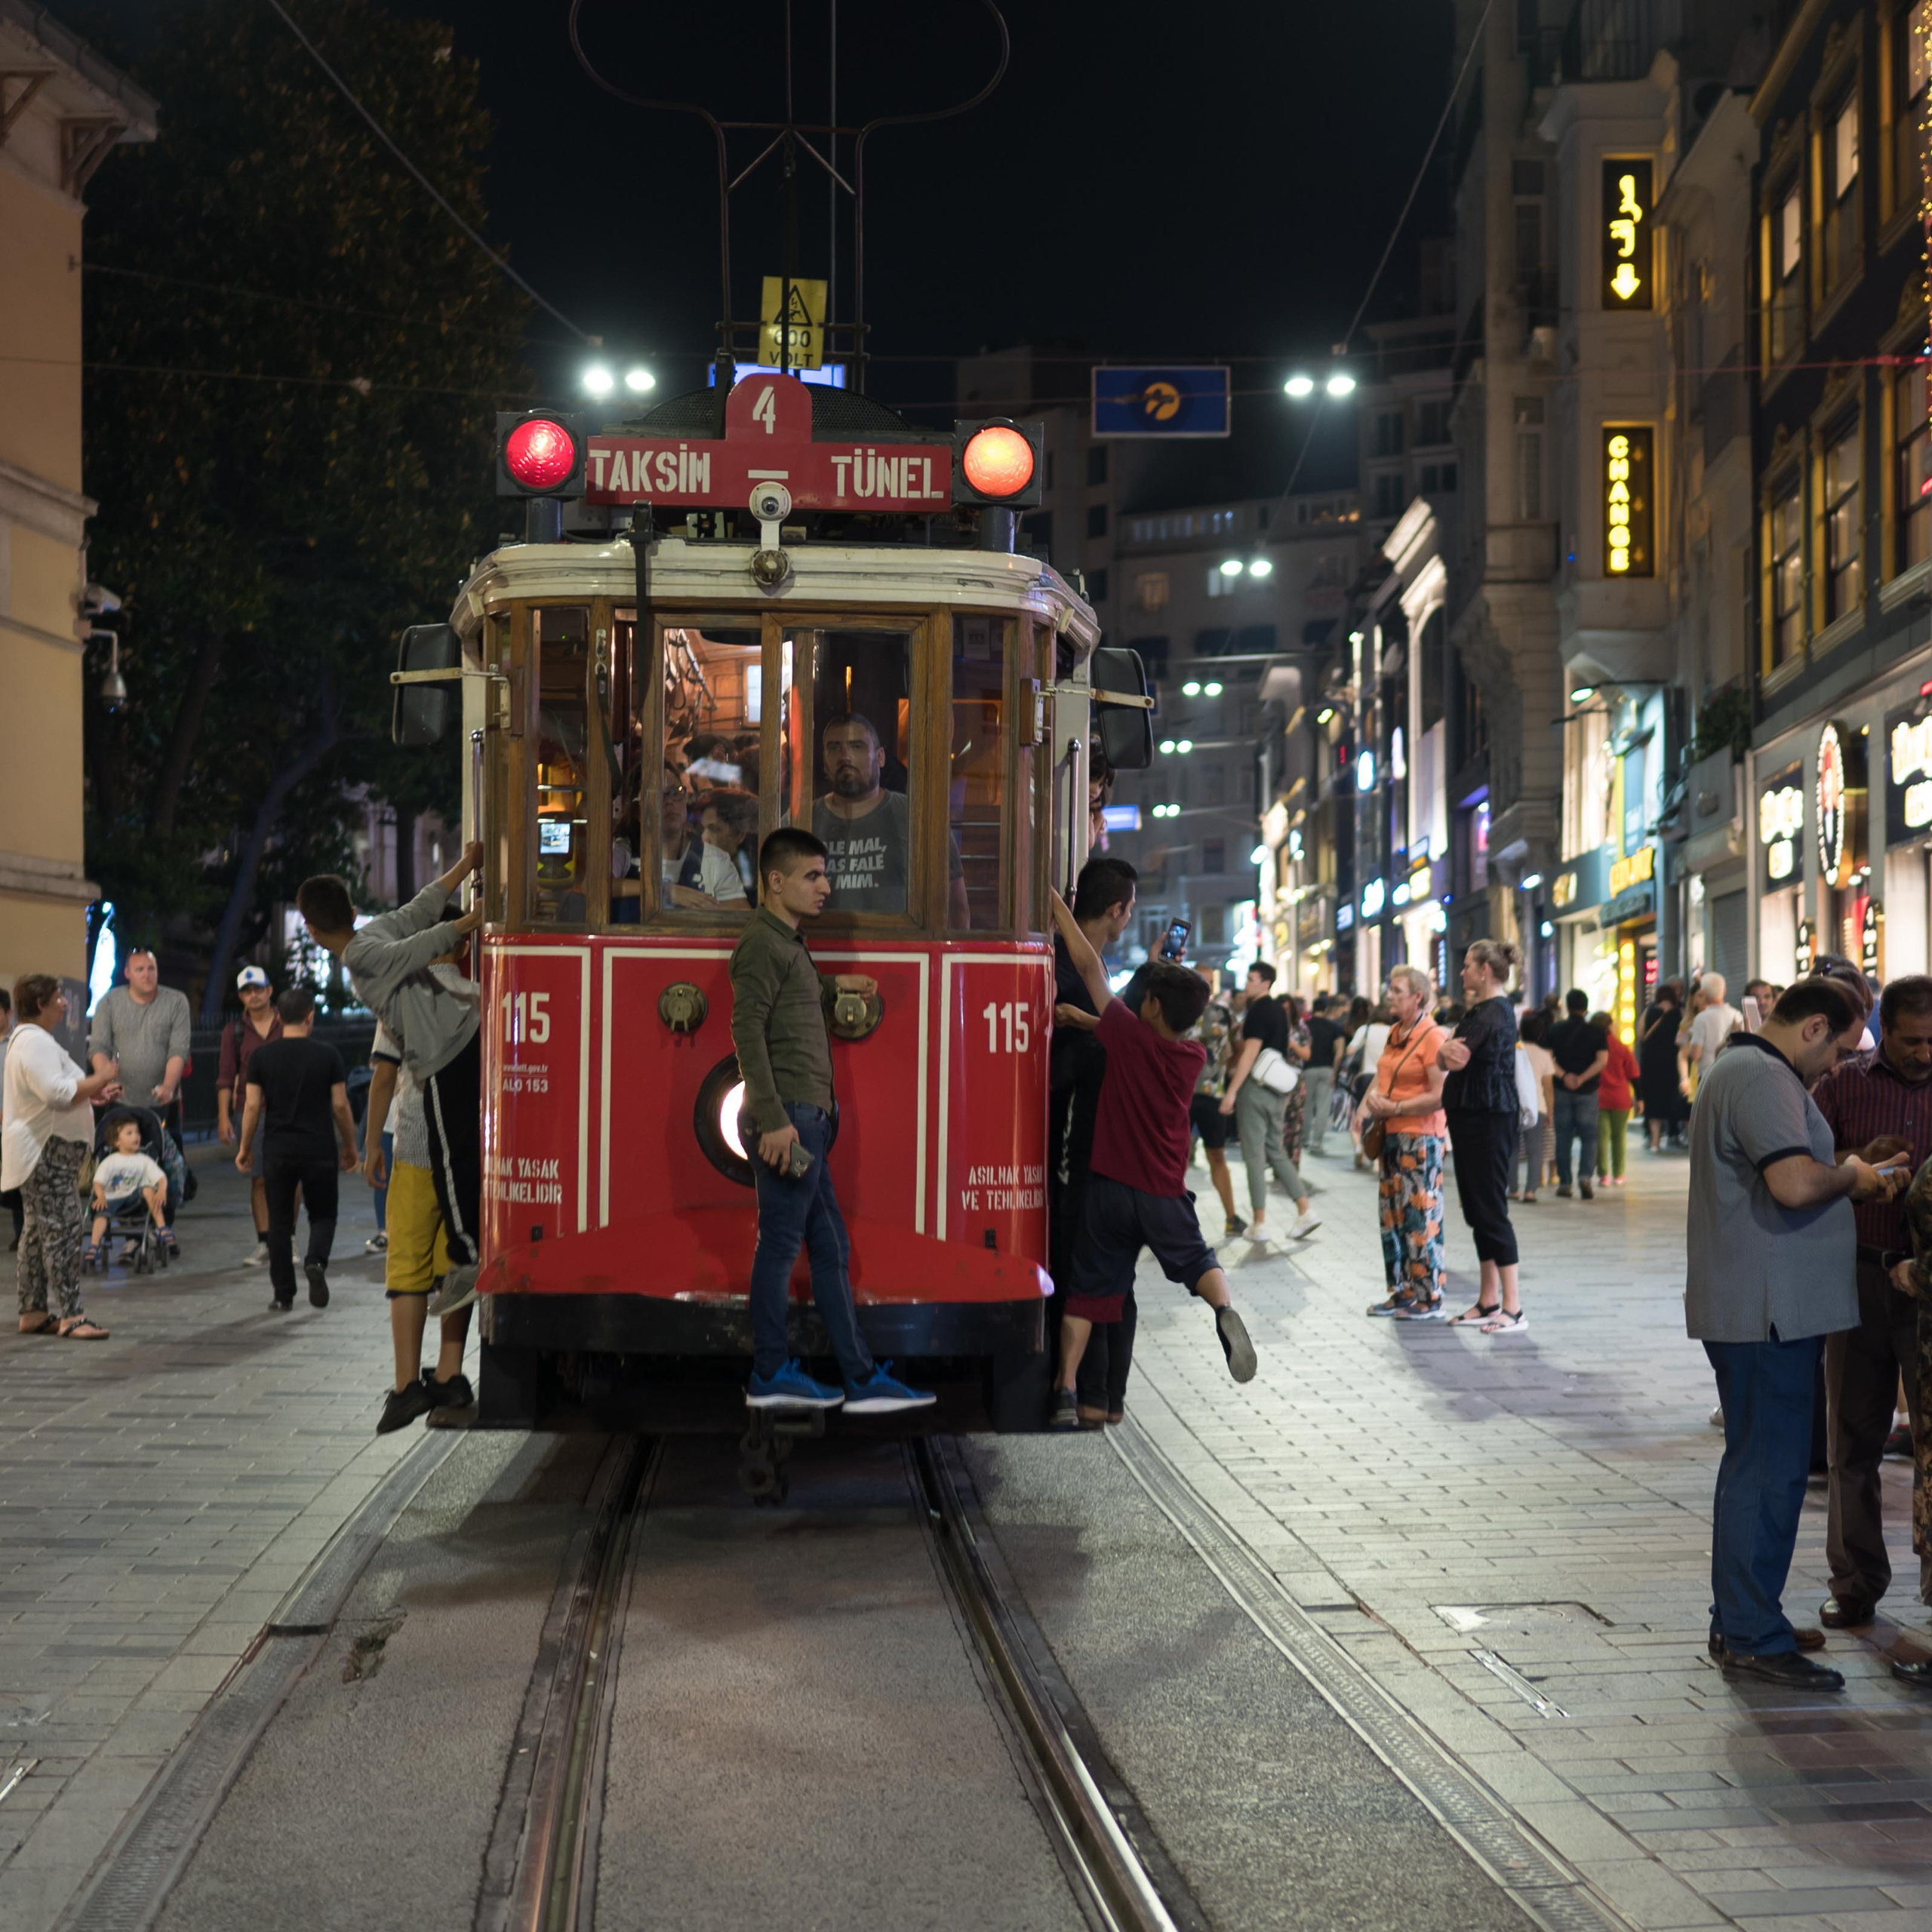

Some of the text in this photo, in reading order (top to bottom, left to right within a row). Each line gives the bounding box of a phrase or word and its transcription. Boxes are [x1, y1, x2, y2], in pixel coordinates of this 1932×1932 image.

[774, 330, 811, 347] 600
[770, 351, 814, 368] VOLT
[752, 386, 776, 434] 4
[589, 443, 943, 498] TAKSİM TÜNEL
[1608, 435, 1631, 571] CHANGE
[848, 837, 888, 855] MAL,
[849, 854, 884, 872] FALE
[835, 873, 879, 890] MIM.
[502, 991, 550, 1043] 115
[983, 1001, 1029, 1054] 115
[503, 1078, 549, 1093] ALO 153
[518, 1157, 559, 1179] YASAK
[968, 1164, 1020, 1186] ASILMAK
[961, 1189, 980, 1211] VE
